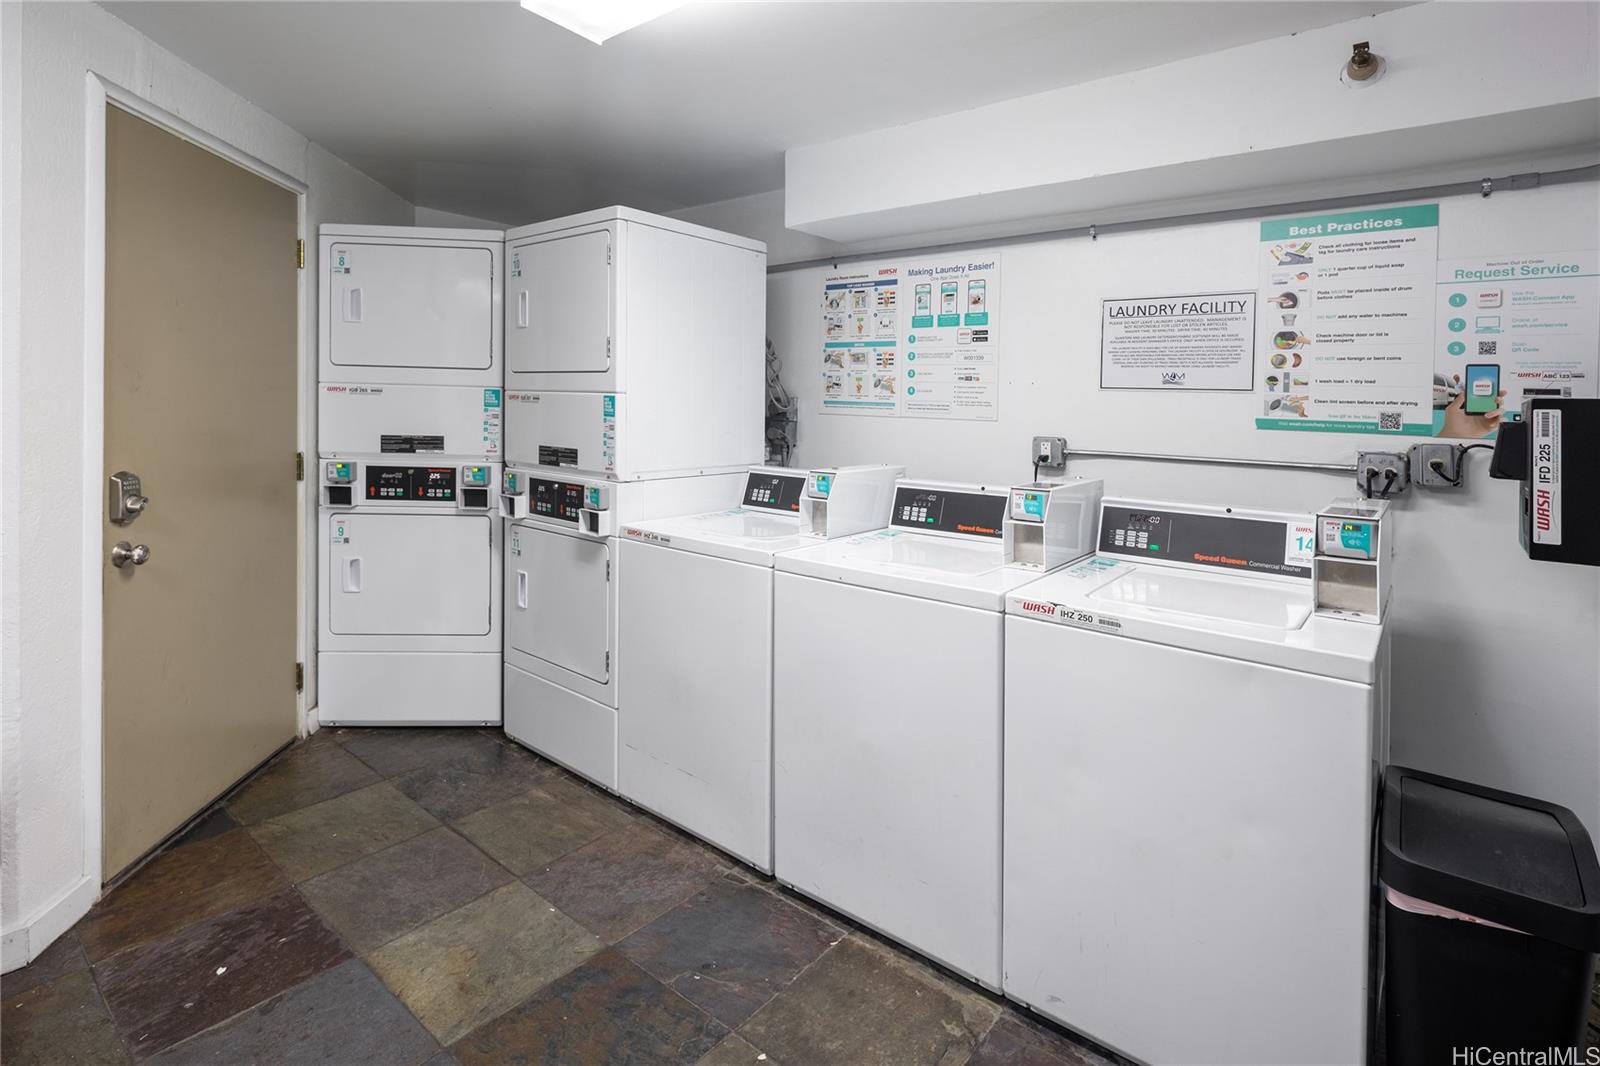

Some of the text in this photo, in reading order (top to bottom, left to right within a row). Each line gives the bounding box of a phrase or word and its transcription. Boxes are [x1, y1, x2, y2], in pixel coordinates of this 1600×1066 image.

[1289, 218, 1403, 236] Best Practices
[339, 256, 345, 266] 8
[908, 262, 994, 276] Making Laundry Easier!
[1455, 264, 1580, 280] Request Service
[1109, 300, 1247, 318] LAUNDRY FACILITY
[1539, 444, 1551, 484] IFD 225
[1537, 489, 1550, 531] WASH
[338, 527, 344, 536] 9
[958, 524, 975, 532] Speed
[1296, 536, 1313, 552] 14
[1194, 553, 1302, 573] Speed Queen Commercial Washer
[1023, 602, 1055, 615] WASH
[1060, 610, 1075, 619] IHZ
[1077, 613, 1093, 623] 250
